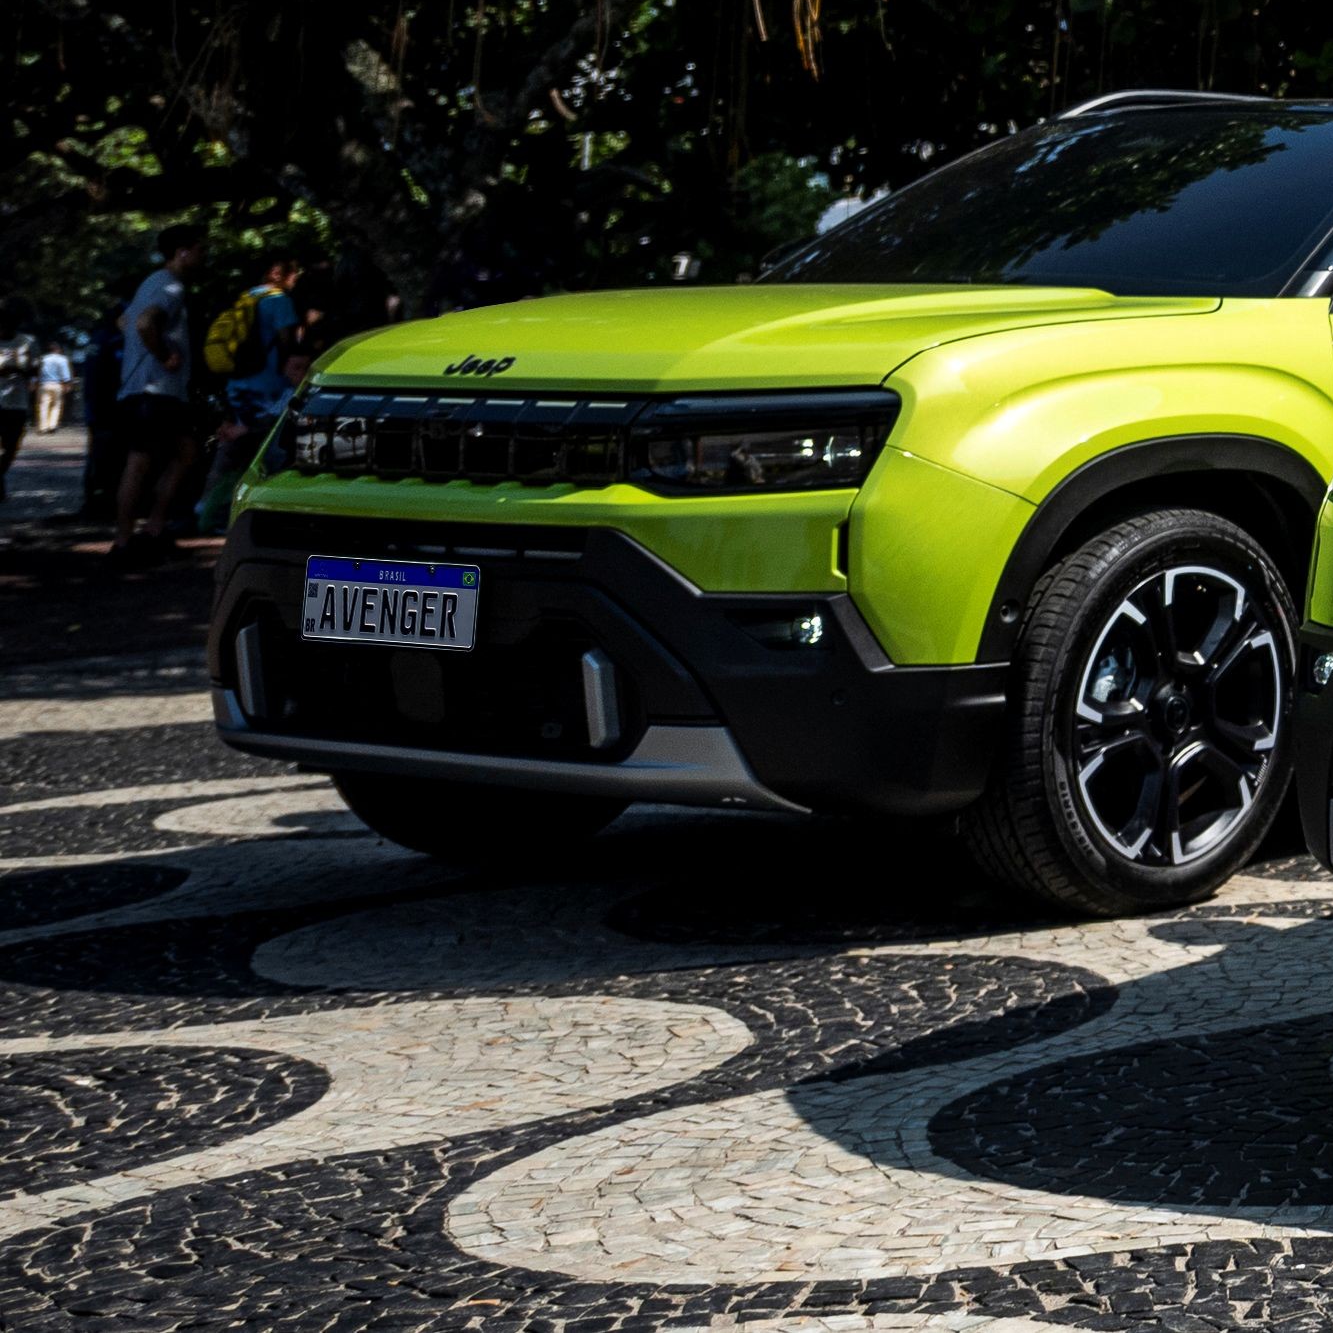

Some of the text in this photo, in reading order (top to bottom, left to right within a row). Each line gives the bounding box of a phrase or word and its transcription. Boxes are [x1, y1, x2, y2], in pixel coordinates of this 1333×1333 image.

[442, 354, 517, 378] Jeep
[378, 570, 407, 582] BRASIL
[319, 584, 459, 639] AVENGER
[305, 617, 316, 633] BR
